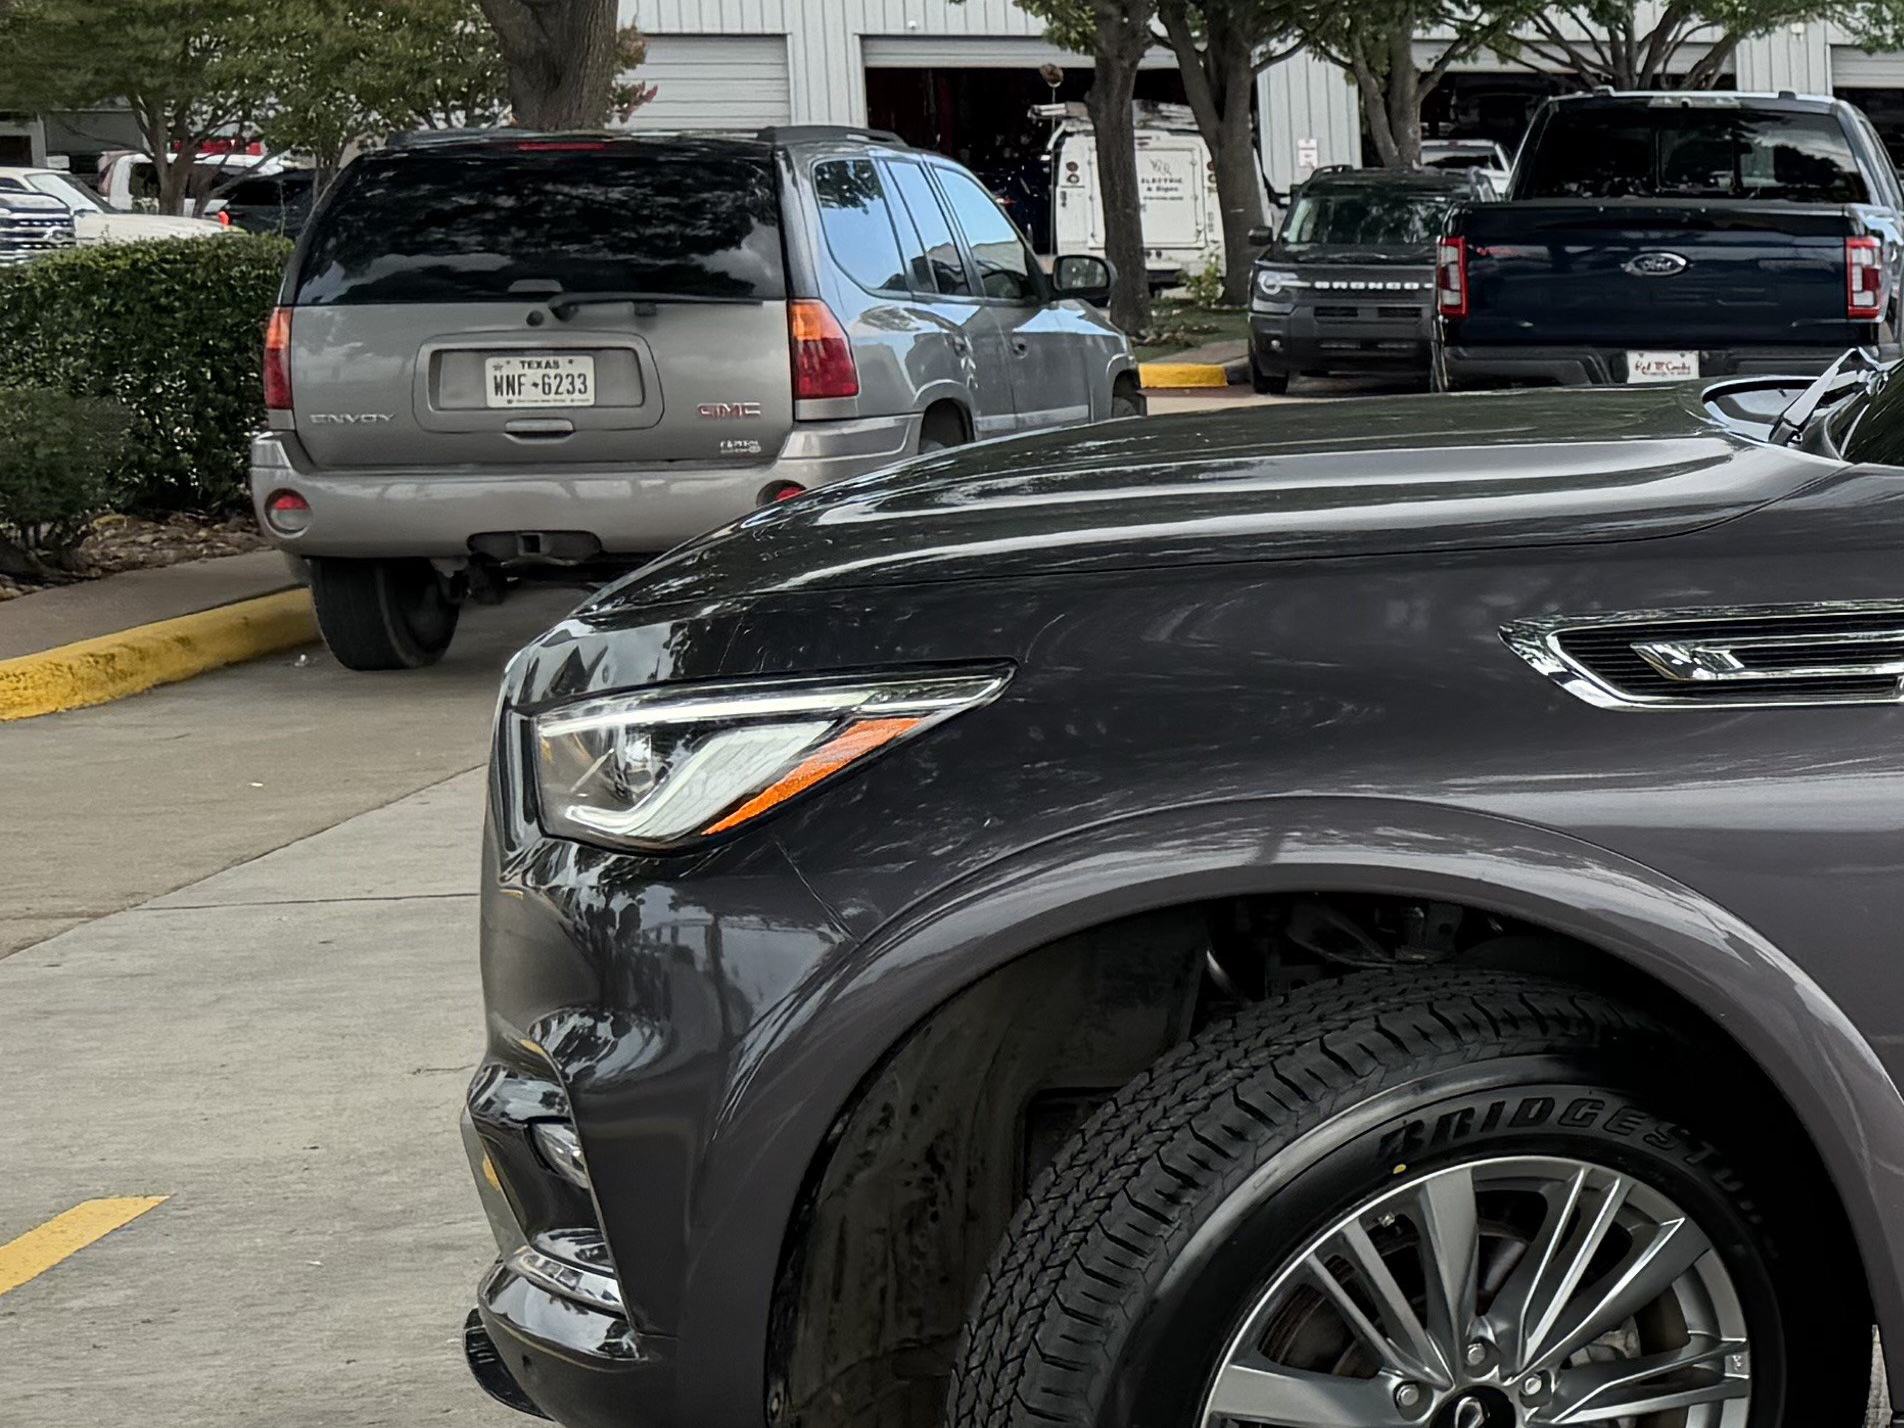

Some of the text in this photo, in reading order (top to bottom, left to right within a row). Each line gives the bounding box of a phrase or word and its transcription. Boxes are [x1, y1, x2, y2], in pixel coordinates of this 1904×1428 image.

[1313, 280, 1420, 291] BRONCO
[519, 360, 560, 370] TEXAS
[697, 402, 761, 418] GMC
[310, 412, 396, 424] ENVOY
